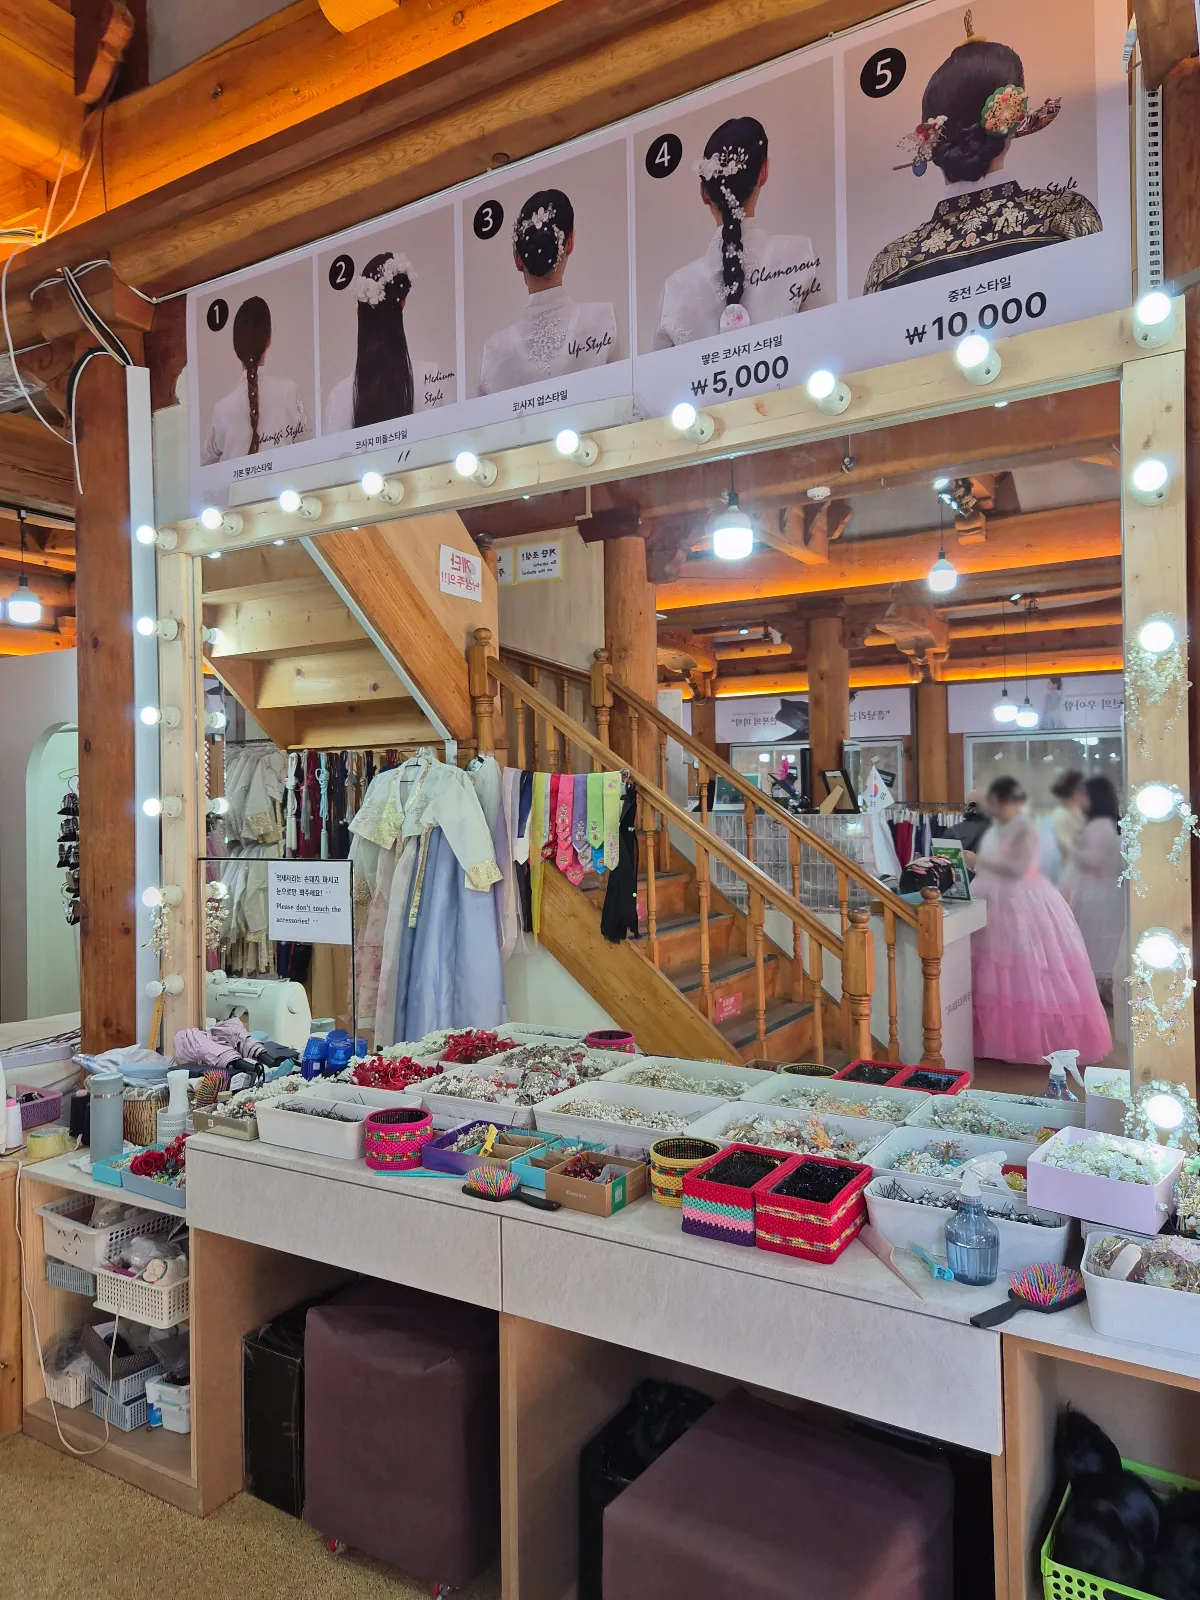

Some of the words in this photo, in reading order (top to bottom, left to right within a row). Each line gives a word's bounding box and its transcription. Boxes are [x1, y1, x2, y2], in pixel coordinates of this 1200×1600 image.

[875, 57, 892, 90] 5
[655, 142, 671, 167] 4
[1046, 176, 1078, 199] Style
[481, 208, 493, 231] 3
[336, 261, 346, 283] 2
[749, 258, 821, 287] Glamorous
[789, 277, 822, 304] Style
[948, 285, 971, 303] 중전
[975, 275, 1012, 295] 스타일
[213, 304, 220, 325] 1
[568, 332, 612, 358] Up-Style
[701, 351, 720, 366] 땋은
[722, 343, 751, 360] 코사지
[753, 334, 783, 352] 스타일
[424, 370, 455, 385] Medium
[690, 355, 789, 397] ₩5,000
[424, 388, 444, 406] Style
[512, 397, 535, 412] 코사지
[537, 389, 568, 406] 업스타일
[286, 422, 304, 440] Style
[355, 437, 374, 449] 코사지
[375, 429, 408, 445] 미들스타일
[233, 468, 244, 478] 기본
[322, 875, 339, 884] 마시고
[276, 903, 294, 911] Please
[296, 904, 311, 912] don't
[276, 917, 310, 925] accessories!
